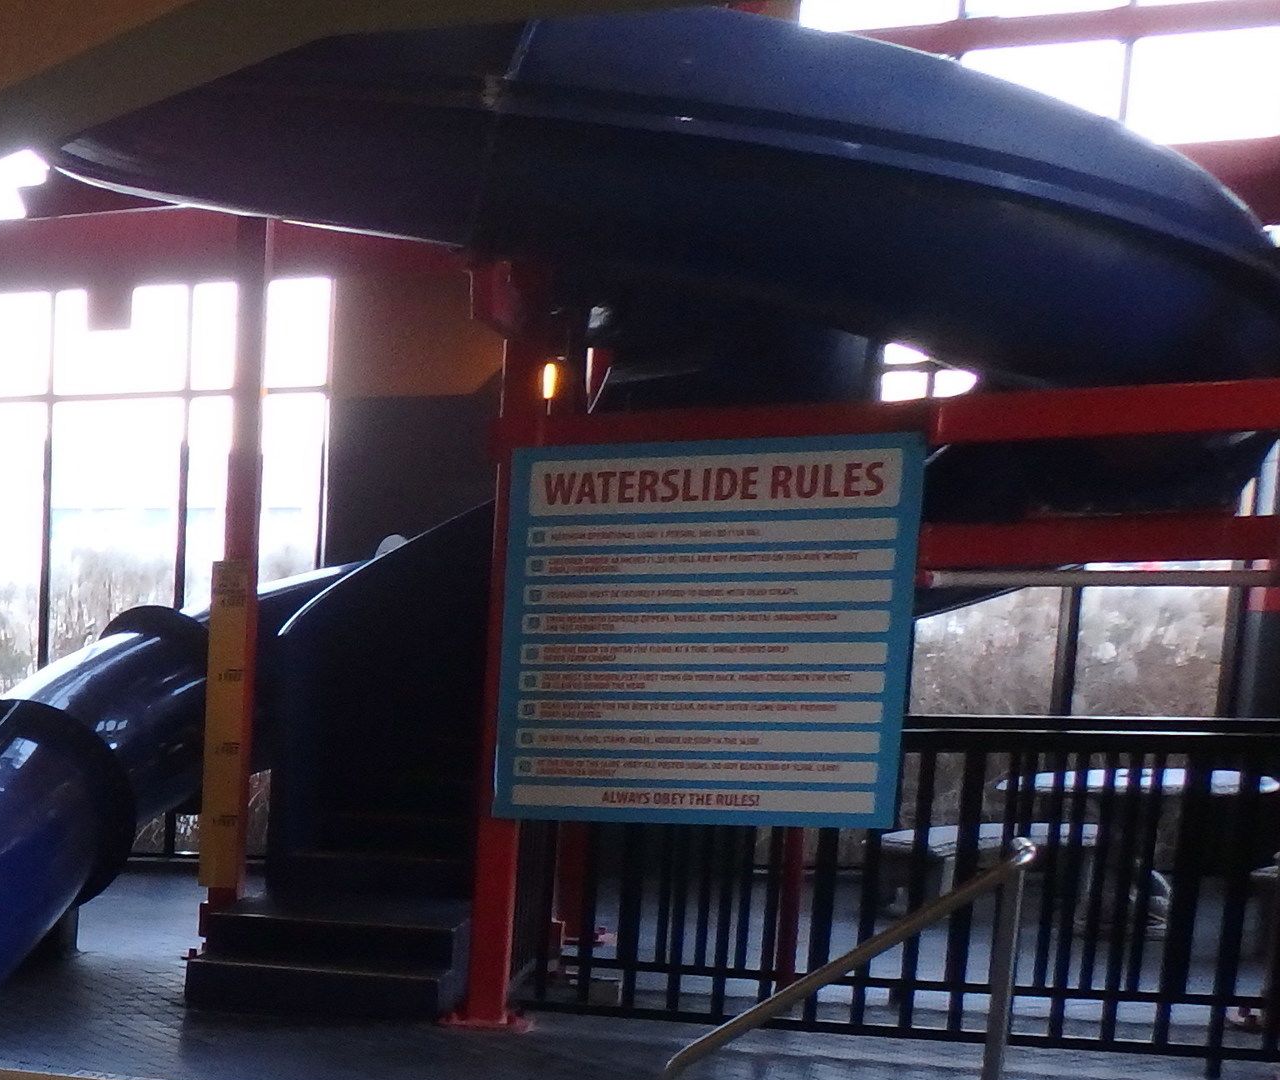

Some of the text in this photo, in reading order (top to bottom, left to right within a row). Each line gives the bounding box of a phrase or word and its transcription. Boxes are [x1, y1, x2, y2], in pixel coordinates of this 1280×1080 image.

[544, 461, 886, 506] WATERSLIDE RULES
[602, 791, 760, 808] ALWAYS OBEY THE RULES!
